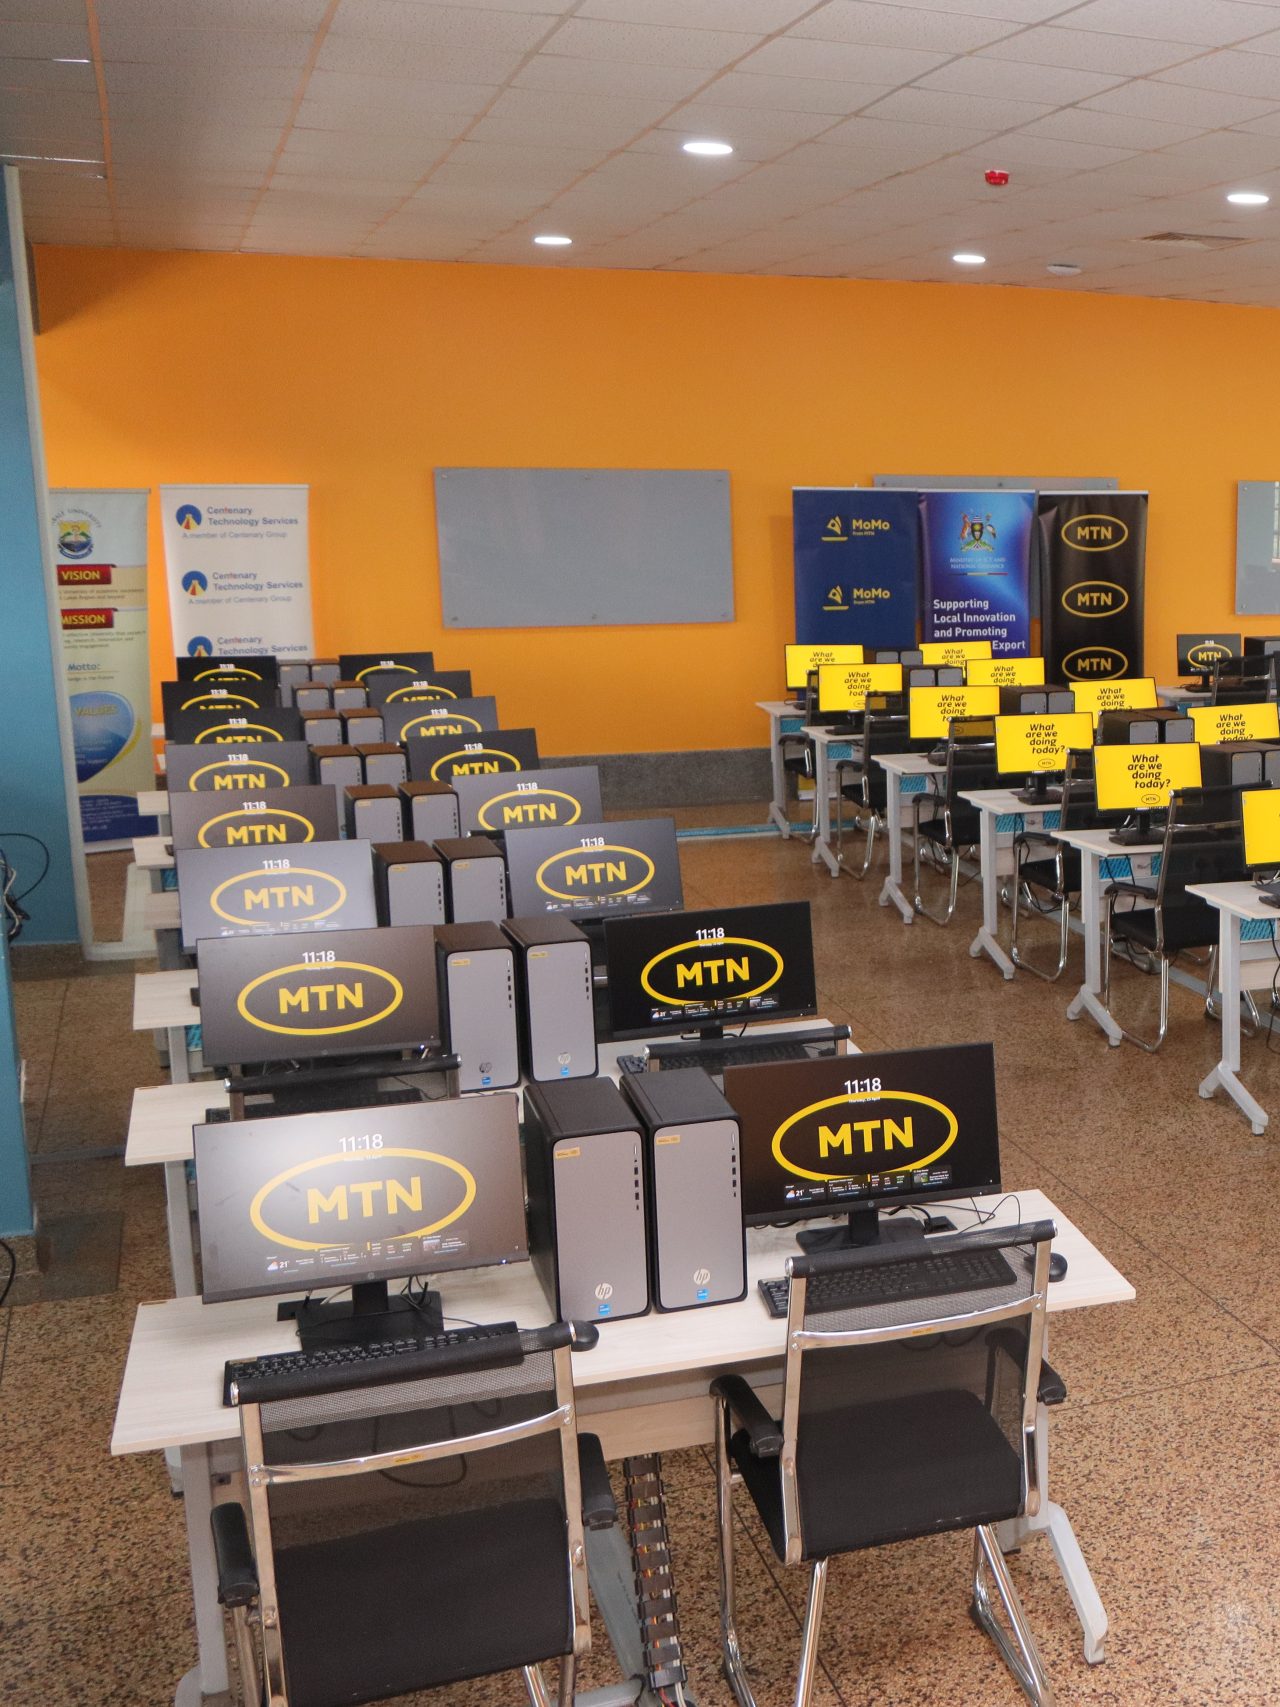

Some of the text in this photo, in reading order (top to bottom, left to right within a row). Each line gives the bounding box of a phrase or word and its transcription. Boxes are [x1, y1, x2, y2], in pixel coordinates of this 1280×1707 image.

[207, 506, 252, 515] Centenary
[208, 516, 298, 526] Technology Services
[852, 519, 890, 530] MoMo
[1076, 526, 1112, 540] MTN
[61, 571, 100, 581] VISION
[212, 572, 257, 581] Centenary
[213, 581, 303, 591] Technology Services
[853, 588, 891, 599] MoMo
[1076, 592, 1112, 606] MTN
[933, 599, 989, 611] Supporting
[934, 612, 1016, 623] Local Innovation
[934, 626, 1007, 638] and Promoting
[217, 636, 262, 645] Centenary
[992, 640, 1026, 651] Export
[218, 645, 308, 655] Technology Services
[67, 663, 101, 671] Motto:
[1076, 658, 1112, 671] MTN
[420, 724, 462, 736] MTN
[464, 742, 483, 751] 11:18
[1029, 739, 1057, 747] doing
[1032, 746, 1065, 754] today?
[228, 753, 249, 763] 11:18
[452, 760, 499, 775] MTN
[213, 773, 266, 790] MTN
[516, 782, 538, 792] 11:18
[242, 801, 267, 813] 11:18
[503, 802, 556, 824] MTN
[226, 823, 286, 845] MTN
[581, 837, 605, 847] 11:18
[262, 859, 290, 872] 11:18
[565, 861, 627, 886] MTN
[243, 885, 315, 911] MTN
[696, 927, 724, 940] 11:18
[302, 950, 336, 964] 11:18
[676, 957, 750, 988] MTN
[278, 982, 364, 1014] MTN
[844, 1078, 881, 1094] 11:18
[338, 1133, 383, 1153] 11:18
[818, 1116, 913, 1158] MTN
[307, 1176, 423, 1224] MTN
[693, 1268, 711, 1285] hp
[595, 1282, 613, 1300] hp
